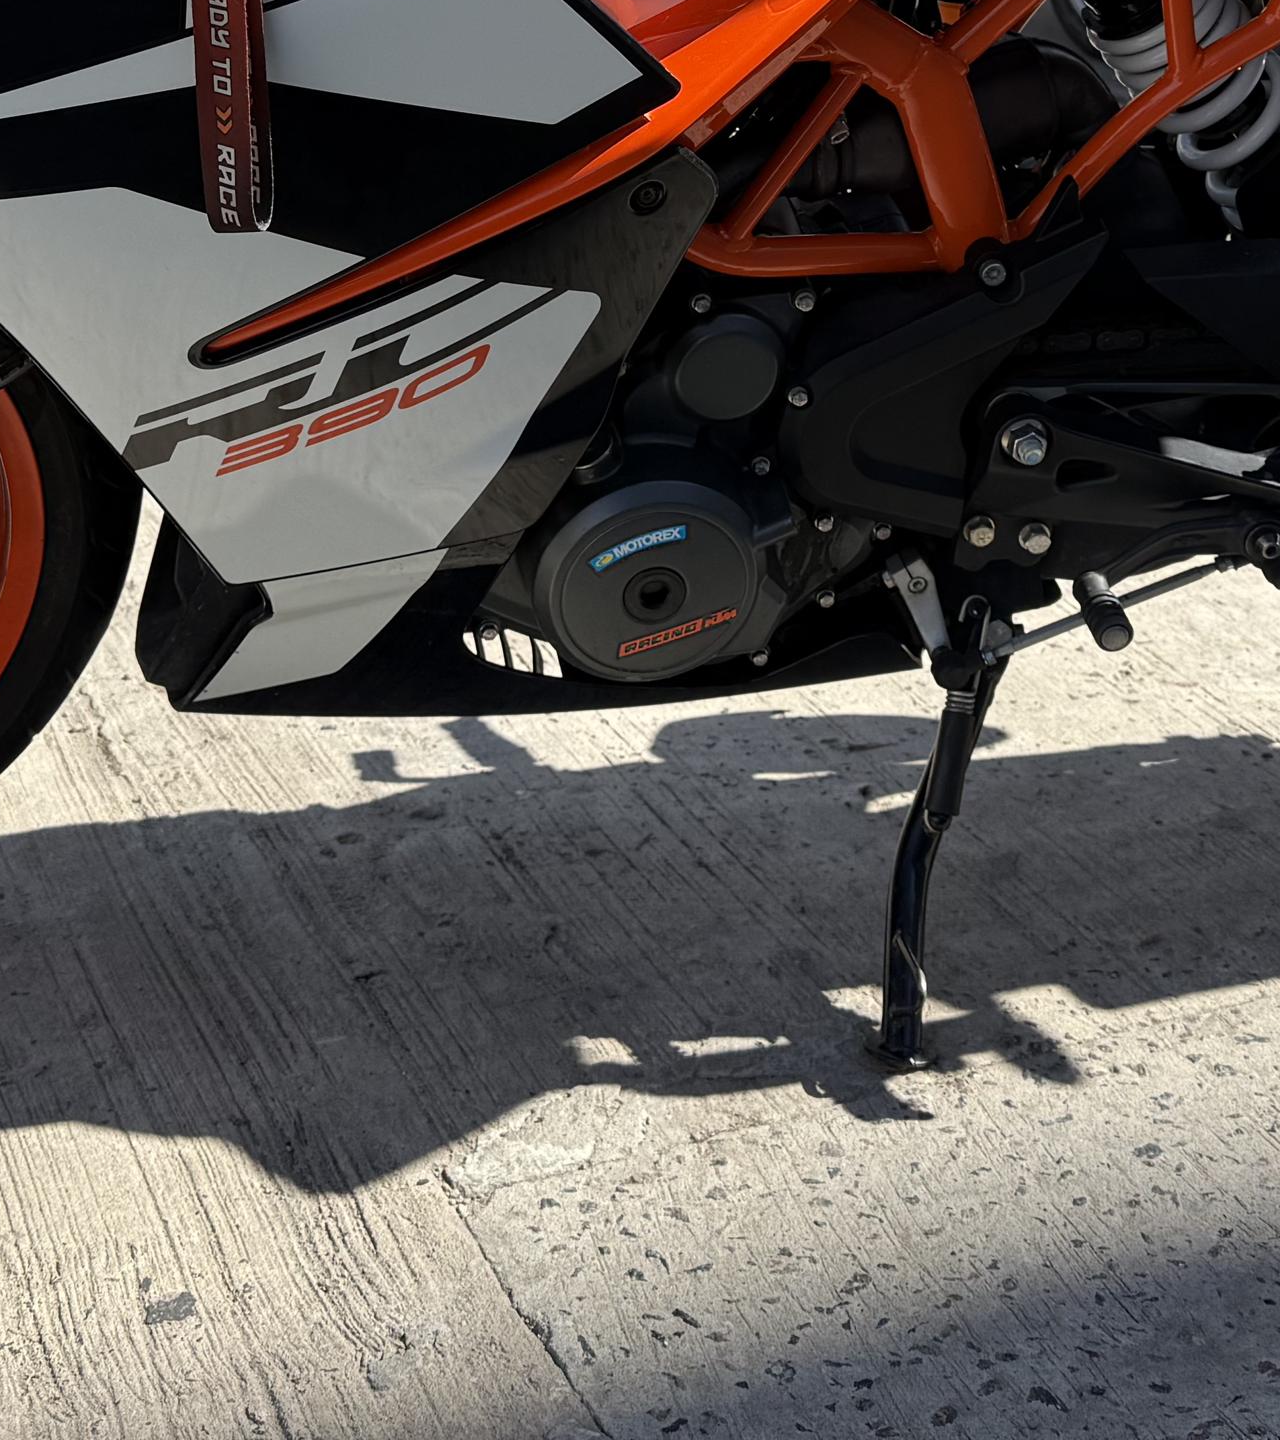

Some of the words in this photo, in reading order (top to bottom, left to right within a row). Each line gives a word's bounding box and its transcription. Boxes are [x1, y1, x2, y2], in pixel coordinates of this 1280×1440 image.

[212, 58, 232, 96] TO
[217, 144, 241, 228] RACE
[215, 344, 491, 477] 390
[612, 527, 681, 558] MOTOREX
